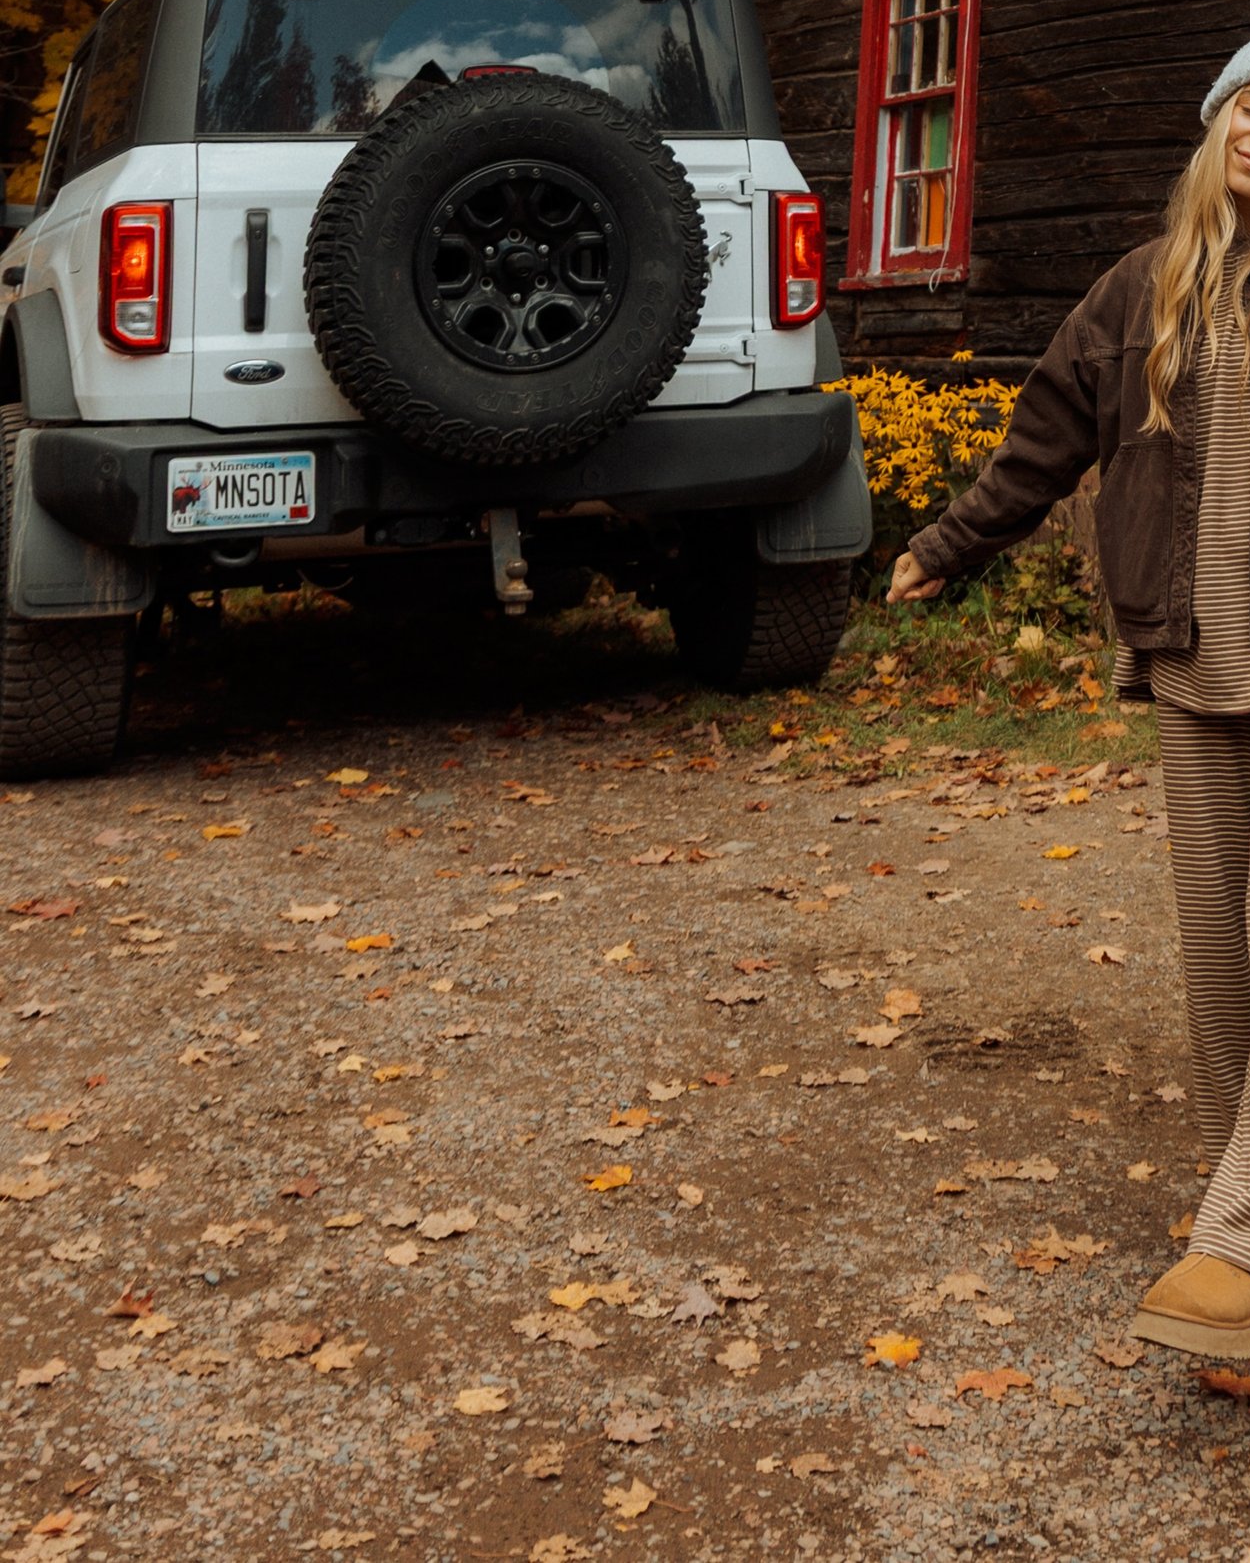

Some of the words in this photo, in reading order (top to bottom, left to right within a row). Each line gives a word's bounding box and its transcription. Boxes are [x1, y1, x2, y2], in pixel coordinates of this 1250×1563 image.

[237, 365, 271, 381] Ford
[209, 461, 275, 473] Minnesota
[215, 470, 306, 510] MNSOTA
[176, 515, 193, 526] MAY
